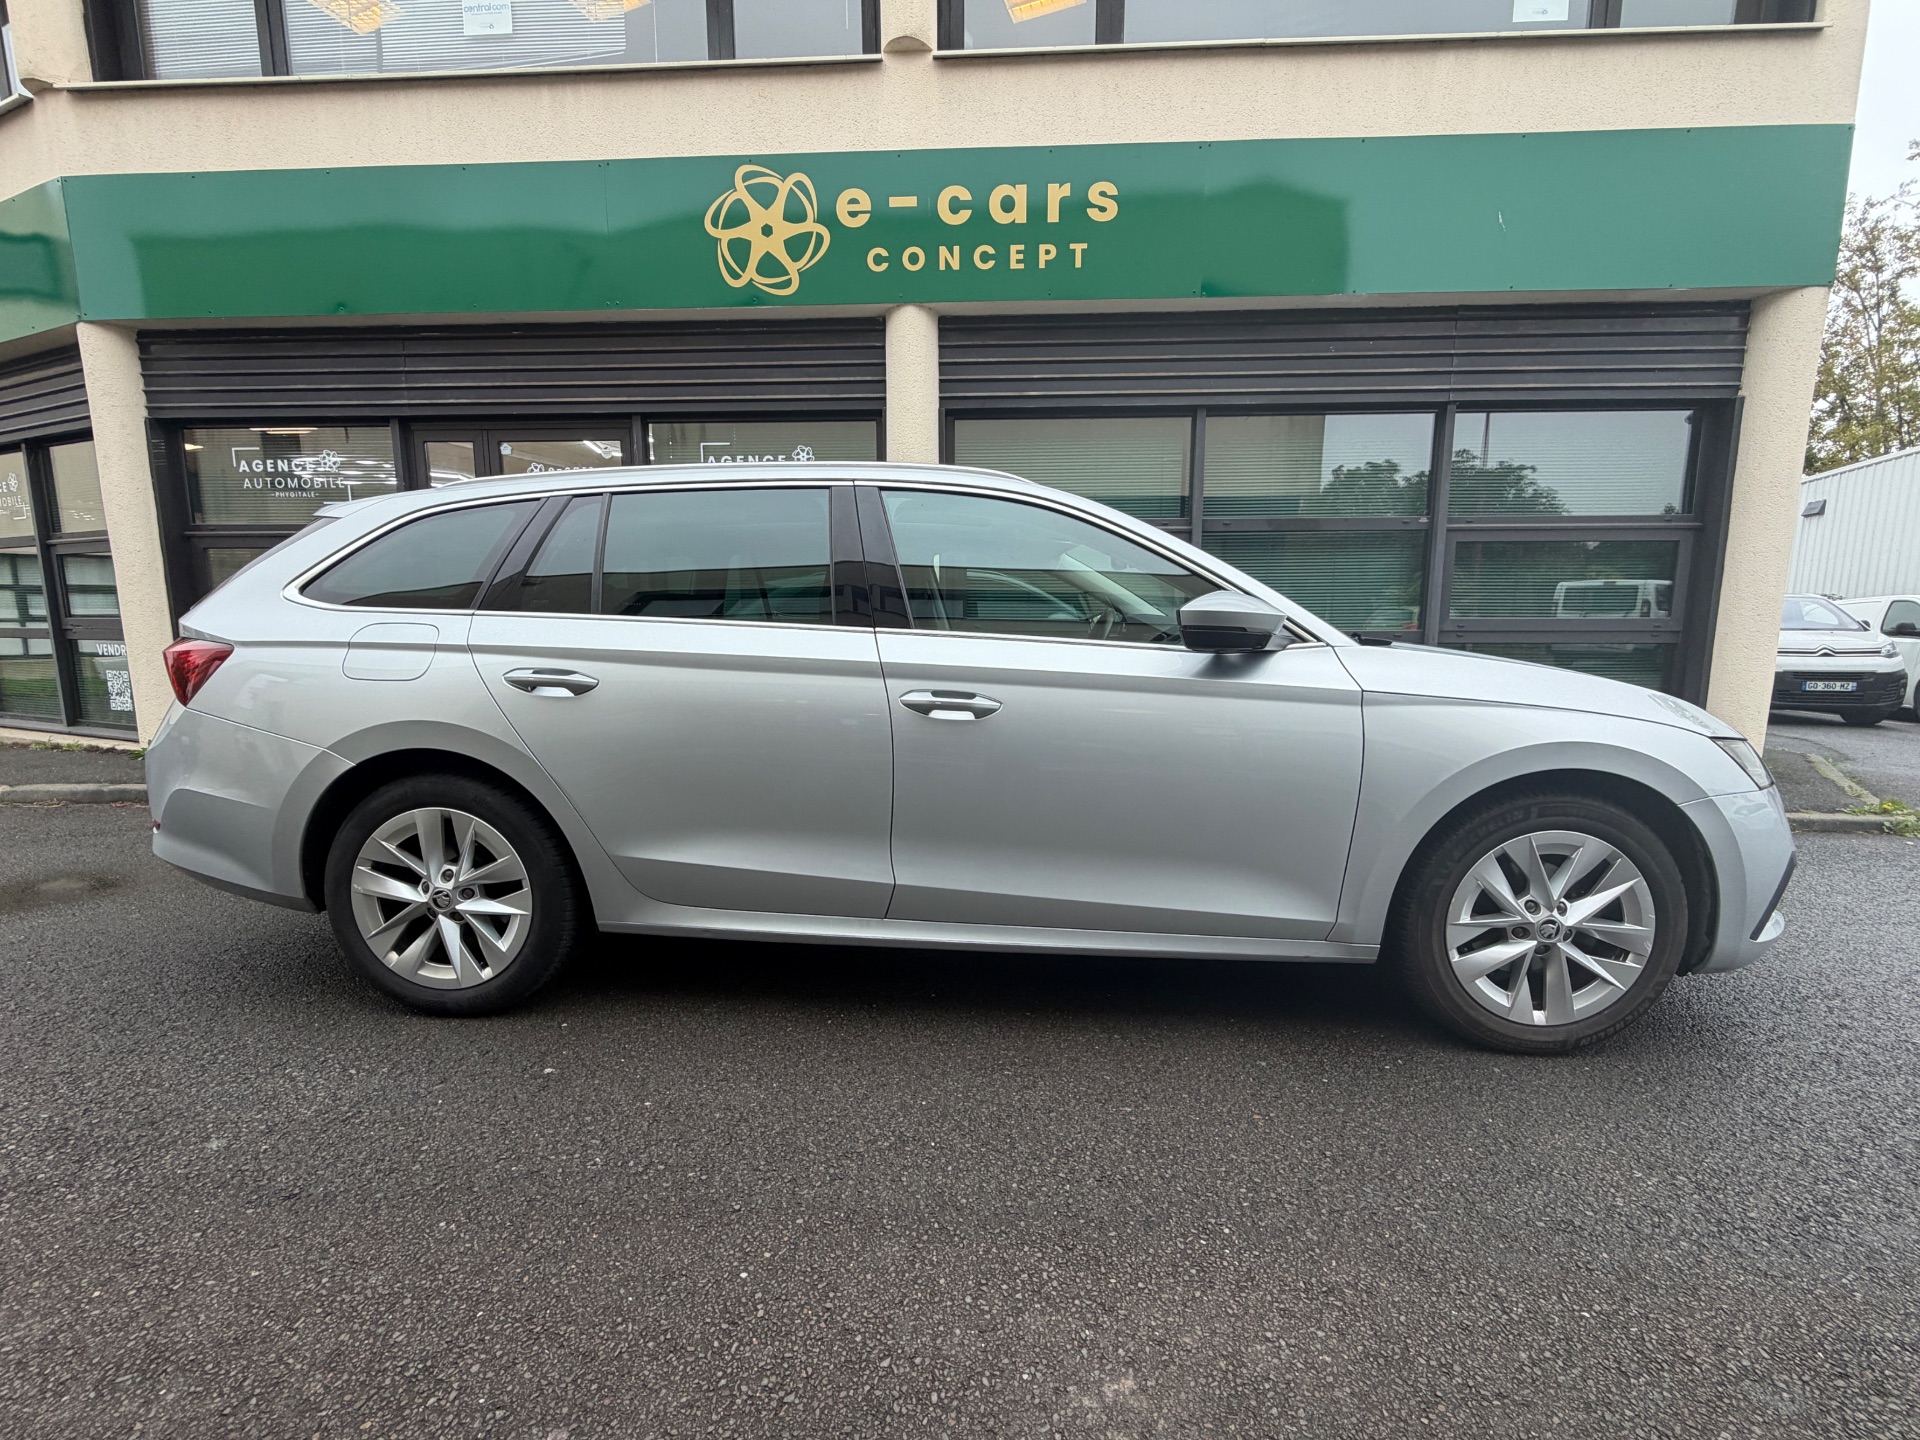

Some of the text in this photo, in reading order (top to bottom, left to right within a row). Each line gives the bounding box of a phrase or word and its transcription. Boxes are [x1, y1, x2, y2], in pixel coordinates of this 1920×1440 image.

[836, 181, 1119, 228] e-cars
[866, 243, 1088, 272] CONCEPT
[239, 459, 315, 473] AGENCE
[243, 477, 345, 489] AUTOMOBILE
